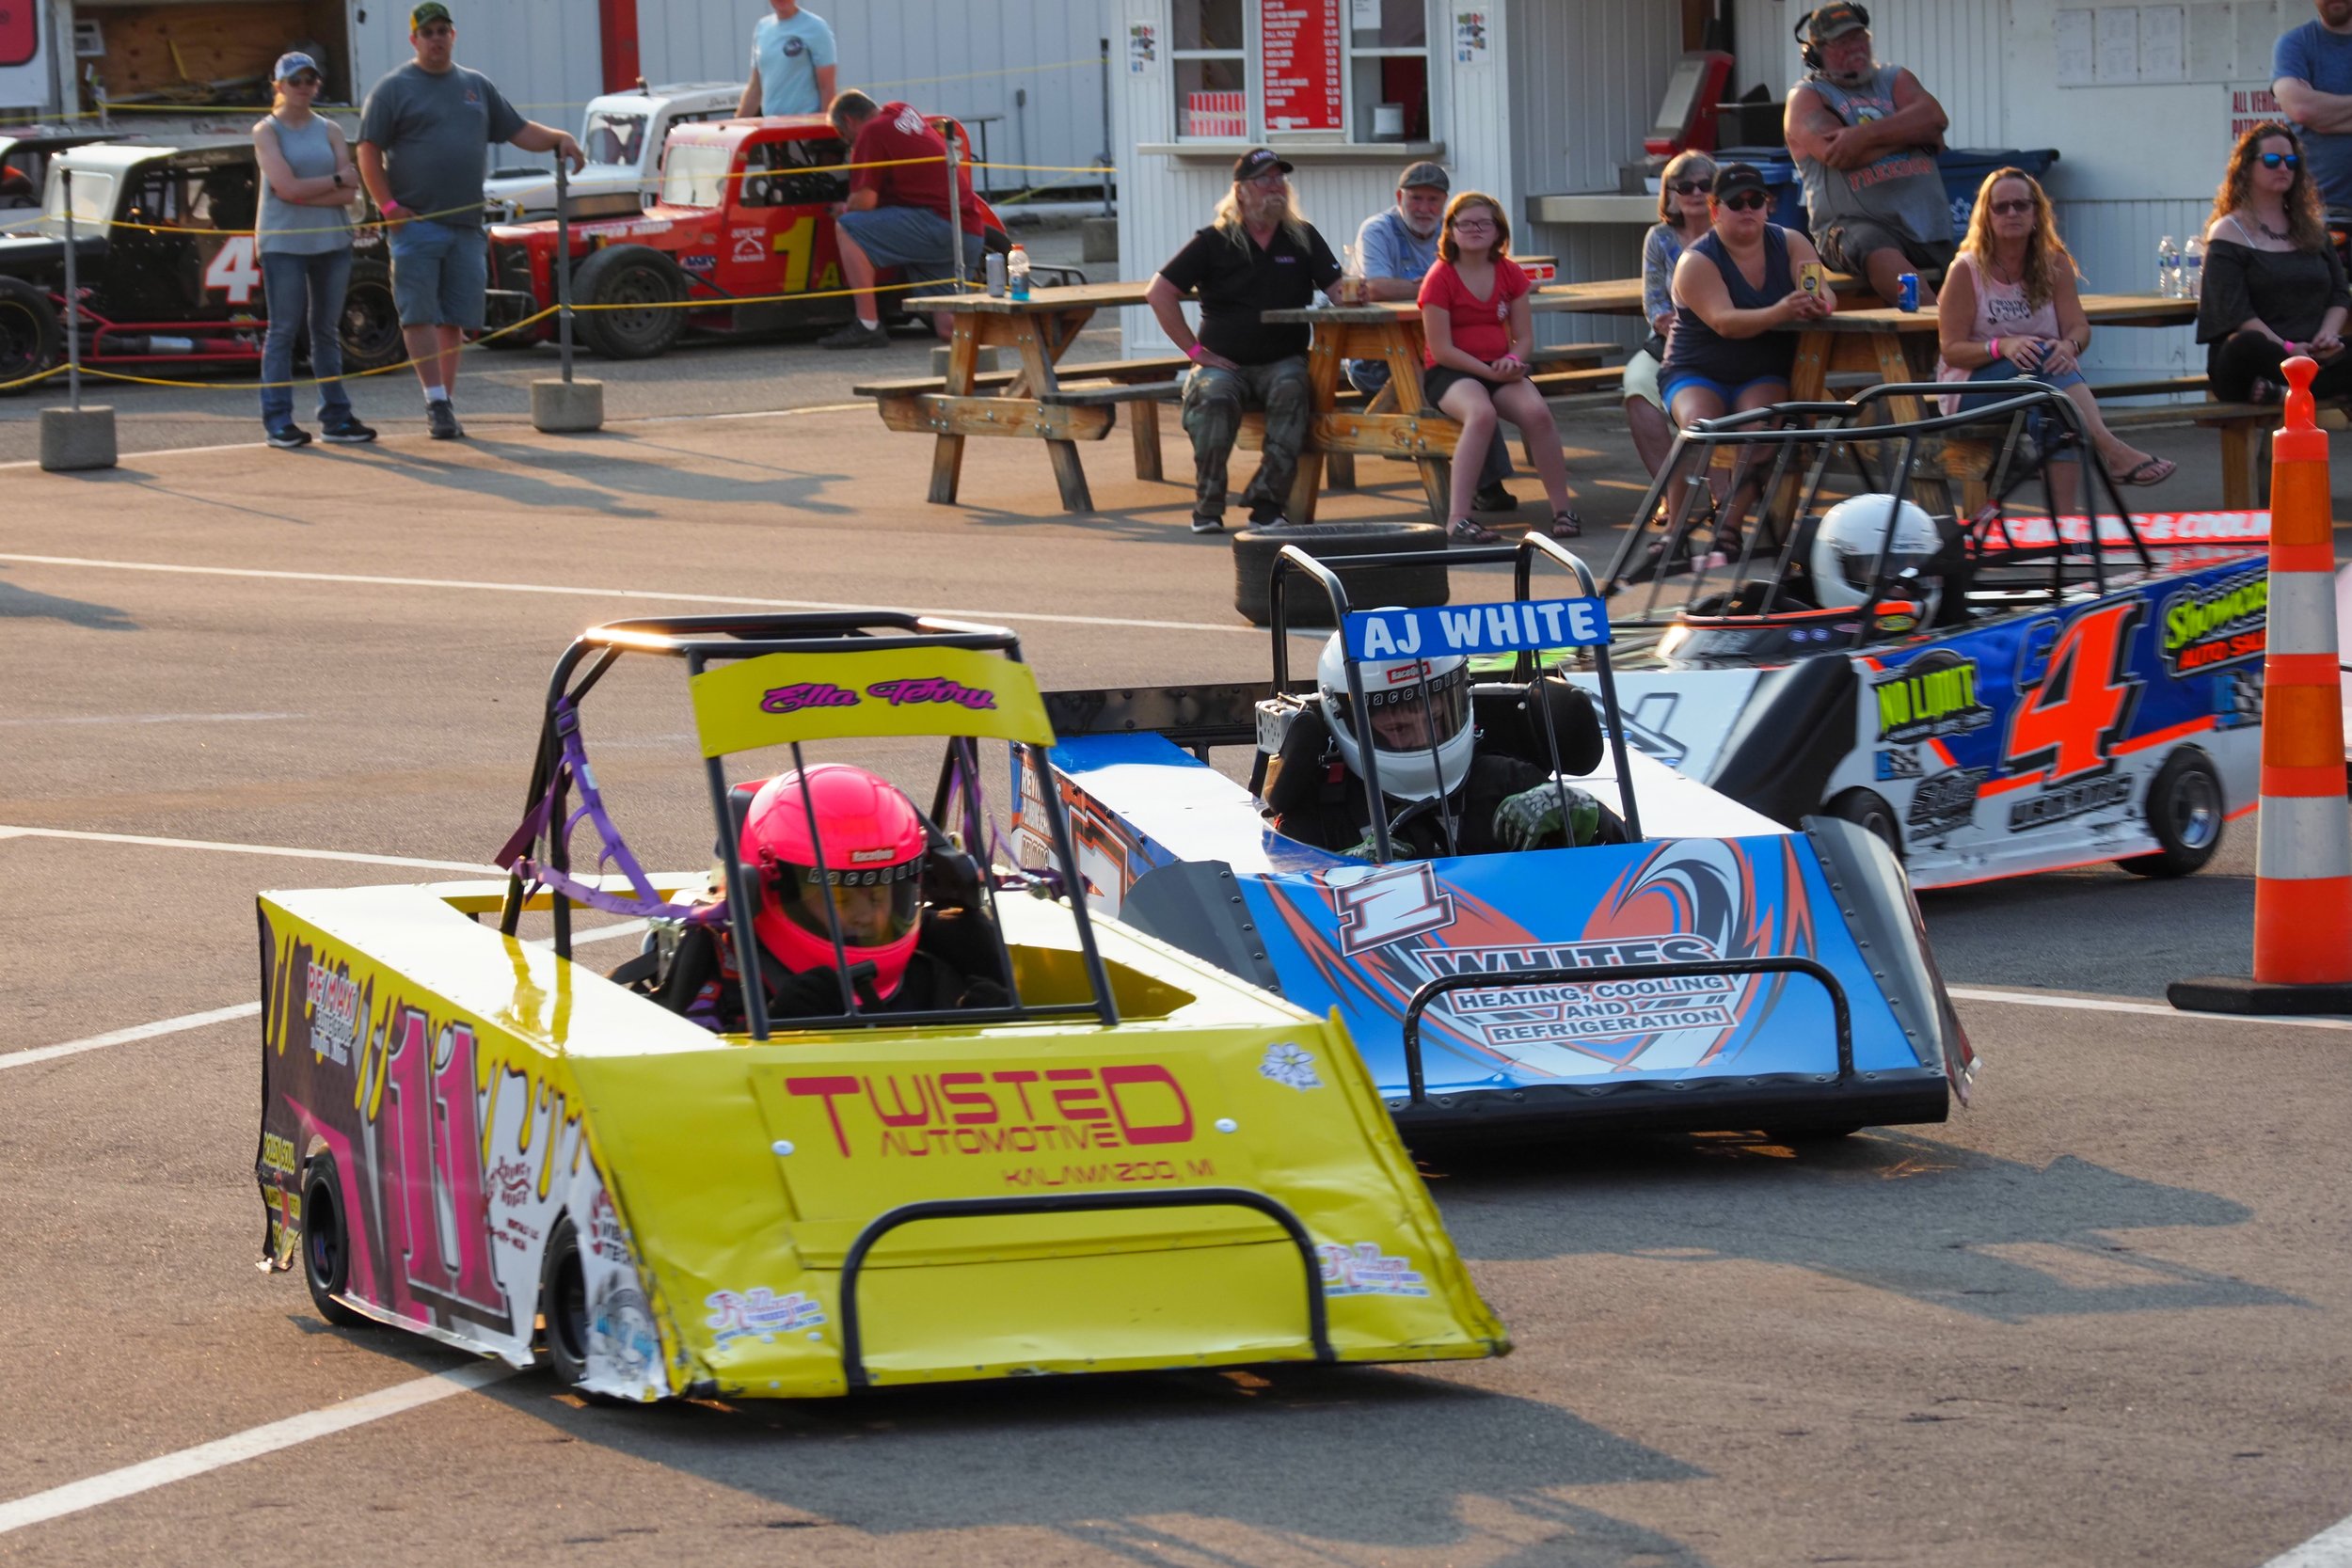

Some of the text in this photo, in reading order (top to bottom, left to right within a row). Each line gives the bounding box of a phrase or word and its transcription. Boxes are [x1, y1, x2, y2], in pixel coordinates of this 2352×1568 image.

[2233, 90, 2282, 113] ALL VEHIC
[631, 220, 674, 235] SHOP
[205, 234, 262, 306] 4
[2176, 513, 2271, 540] COOLIN
[1364, 602, 1598, 658] AJ WHITE
[760, 676, 998, 714] Ella Terry
[2008, 602, 2140, 783] 4
[1334, 862, 1456, 958] 1
[1428, 942, 1718, 976] WHITES
[307, 961, 357, 1020] RE/MAX
[1458, 975, 1724, 1010] HEATING, COOLING
[1493, 1008, 1722, 1041] REFRIGERATION
[1566, 1003, 1625, 1020] AND
[784, 1064, 1195, 1158] TWISTED
[881, 1122, 1121, 1157] AUTOMOTIVE
[386, 1008, 508, 1317] 11
[1185, 1158, 1216, 1178] MI
